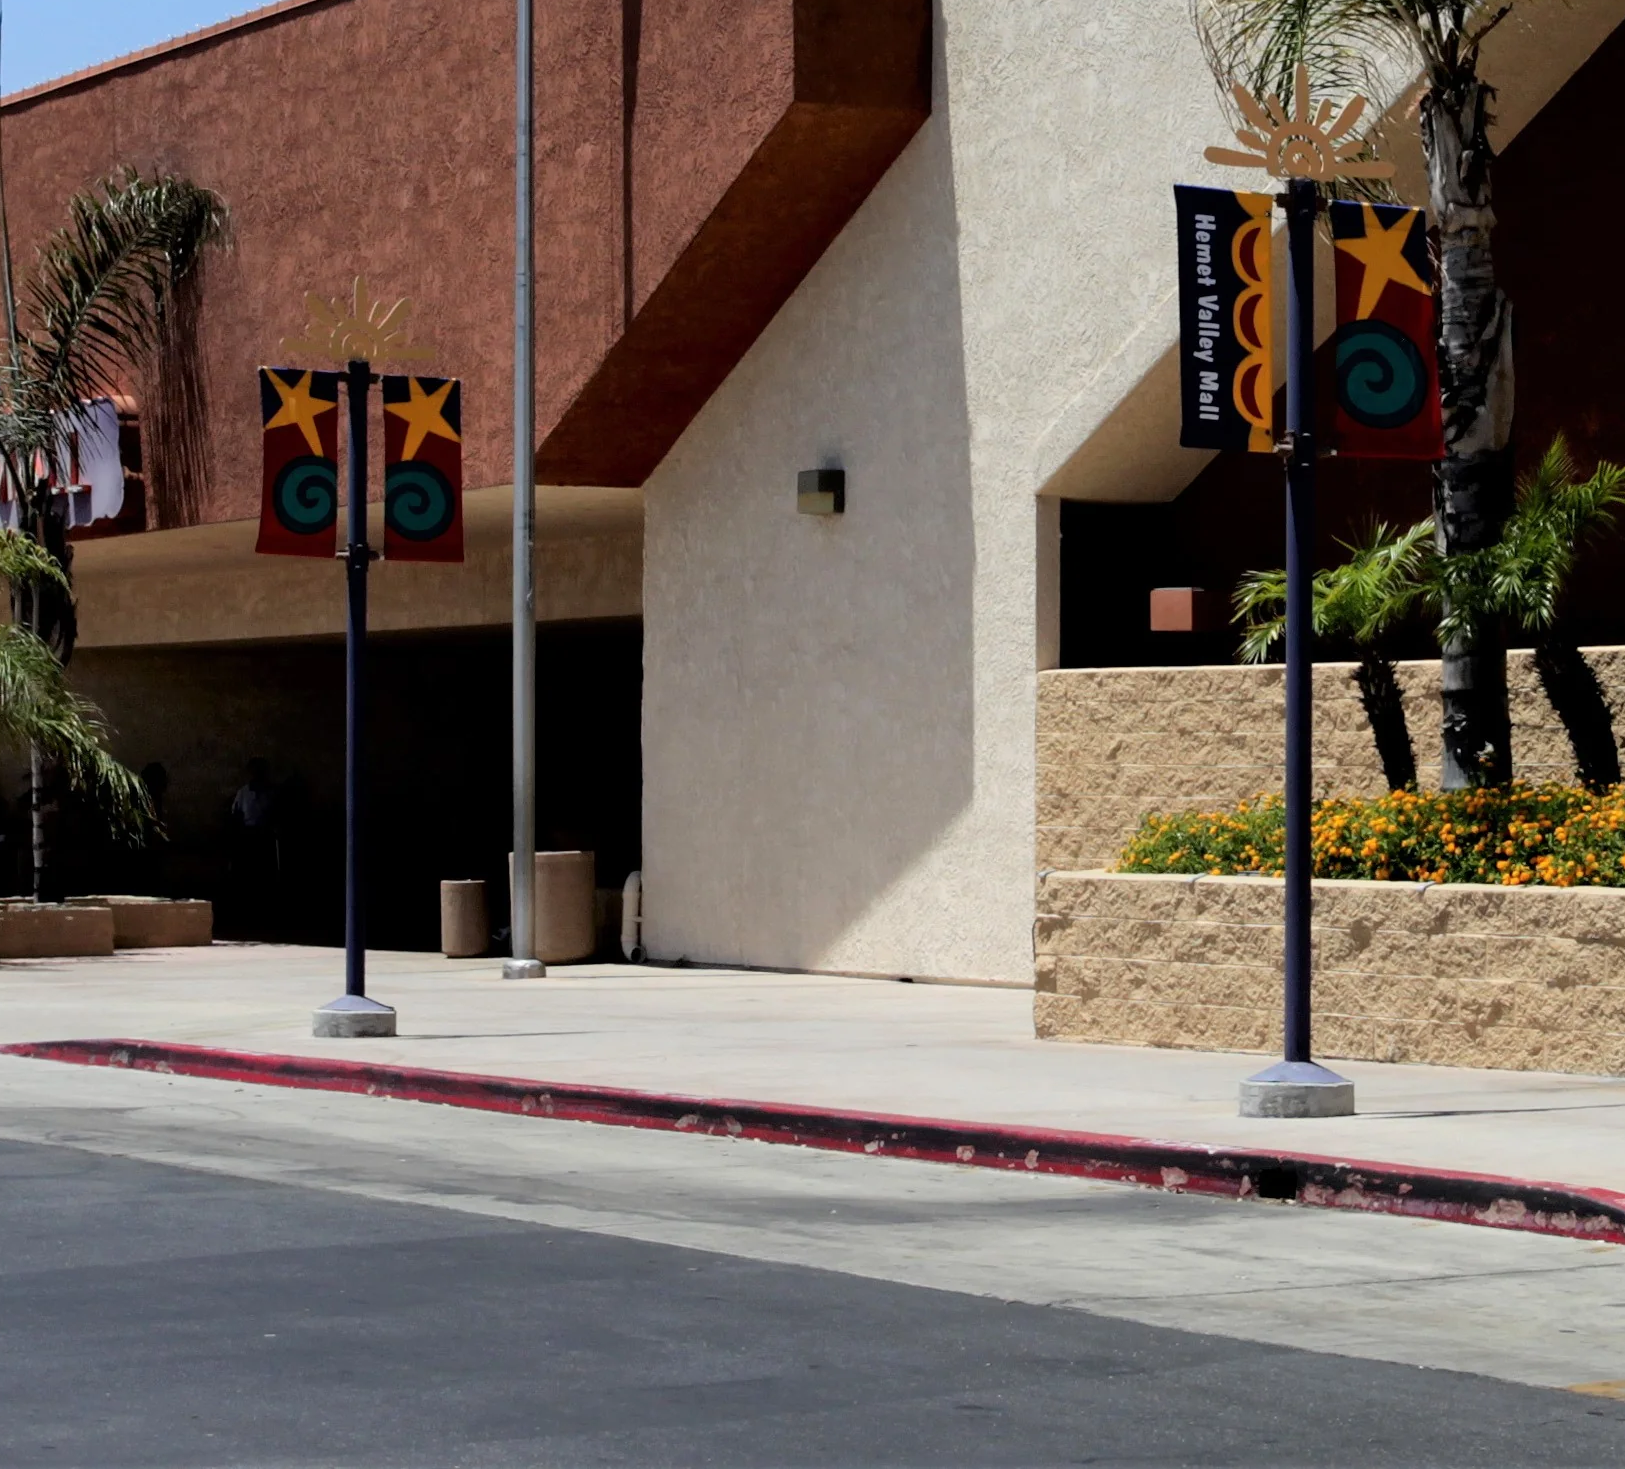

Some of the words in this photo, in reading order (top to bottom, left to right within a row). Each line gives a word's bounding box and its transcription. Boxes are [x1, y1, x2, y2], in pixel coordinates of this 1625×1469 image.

[1194, 213, 1217, 286] Hemet
[1192, 294, 1221, 363] Valley
[1198, 370, 1220, 421] Mall
